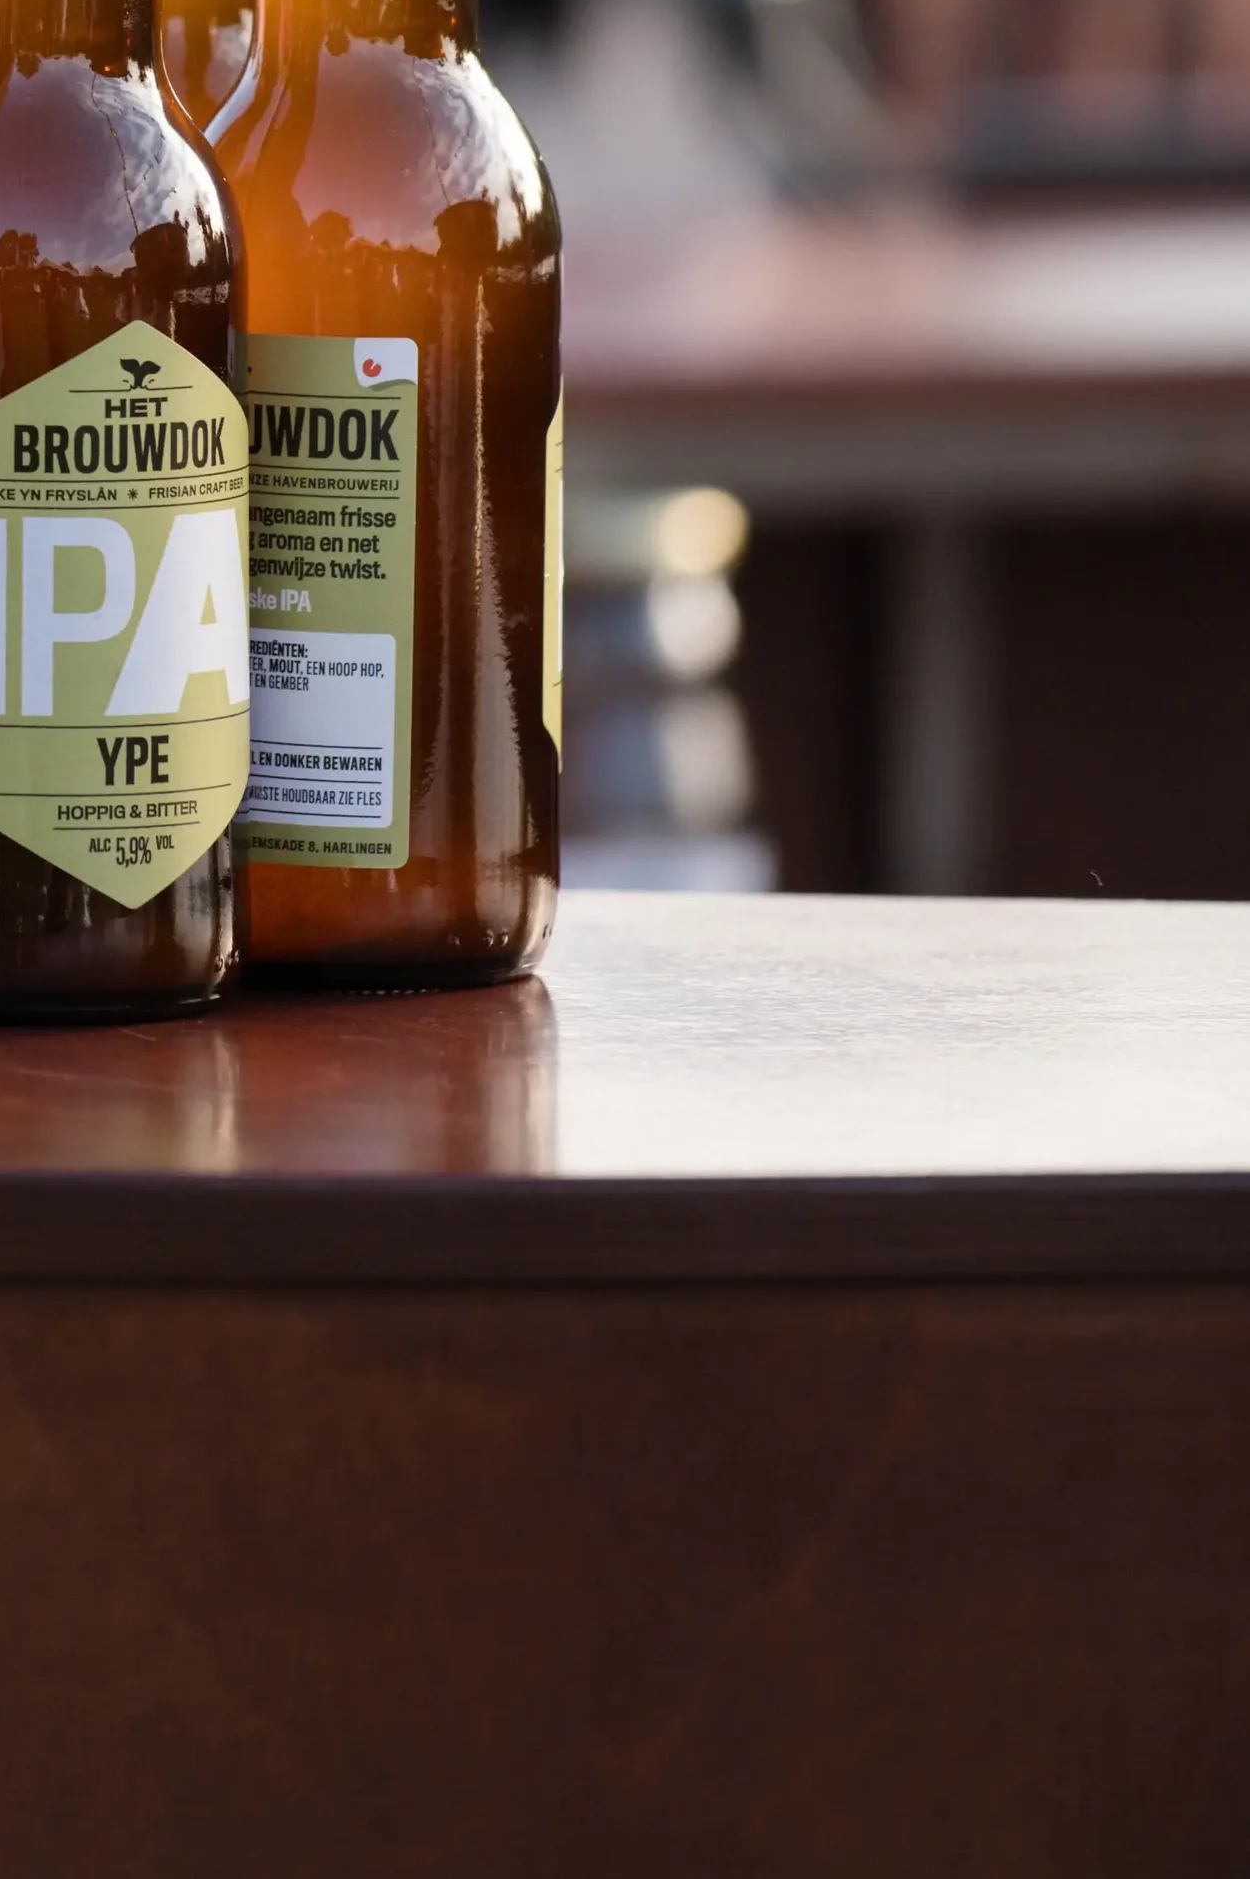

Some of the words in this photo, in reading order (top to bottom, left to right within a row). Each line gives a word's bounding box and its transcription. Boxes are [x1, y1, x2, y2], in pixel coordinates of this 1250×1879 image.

[104, 397, 168, 419] HET
[249, 404, 400, 461] UWDOK
[13, 417, 226, 474] BROUWDOK
[19, 488, 42, 501] YN
[45, 487, 118, 502] FRYSLÂN
[148, 485, 197, 500] FRISIAN
[199, 480, 228, 496] CRAFT
[229, 476, 245, 492] BEER
[249, 472, 270, 486] NZE
[272, 476, 400, 491] HAVENBROUWERIJ
[339, 505, 396, 528] frisse
[257, 532, 315, 552] aroma
[320, 535, 343, 553] en
[348, 534, 380, 554] net
[249, 557, 326, 581] genwijze
[329, 558, 386, 580] twist.
[249, 586, 277, 610] ske
[280, 588, 312, 613] IPA
[250, 639, 309, 658] REDIËNTEN:
[249, 656, 266, 673] TER,
[269, 658, 303, 675] MOUT,
[306, 661, 326, 676] EEN
[328, 662, 358, 677] HOOP
[360, 663, 385, 679] HOP,
[255, 673, 266, 688] EN
[268, 674, 309, 691] GEMBER
[96, 734, 170, 786] YPE
[259, 751, 272, 767] EN
[274, 752, 320, 770] DONKER
[323, 755, 383, 771] BEWAREN
[281, 787, 336, 805] HOUDBAAR
[338, 791, 354, 806] ZIE
[356, 791, 382, 807] FLES
[57, 804, 126, 821] HOPPIG
[129, 804, 142, 819] &
[146, 800, 198, 818] BITTER
[88, 837, 111, 853] ALC
[116, 836, 152, 868] 5,9%
[155, 834, 175, 850] VOL
[251, 836, 305, 852] EMSKADE
[323, 841, 392, 855] HARLINGEN
